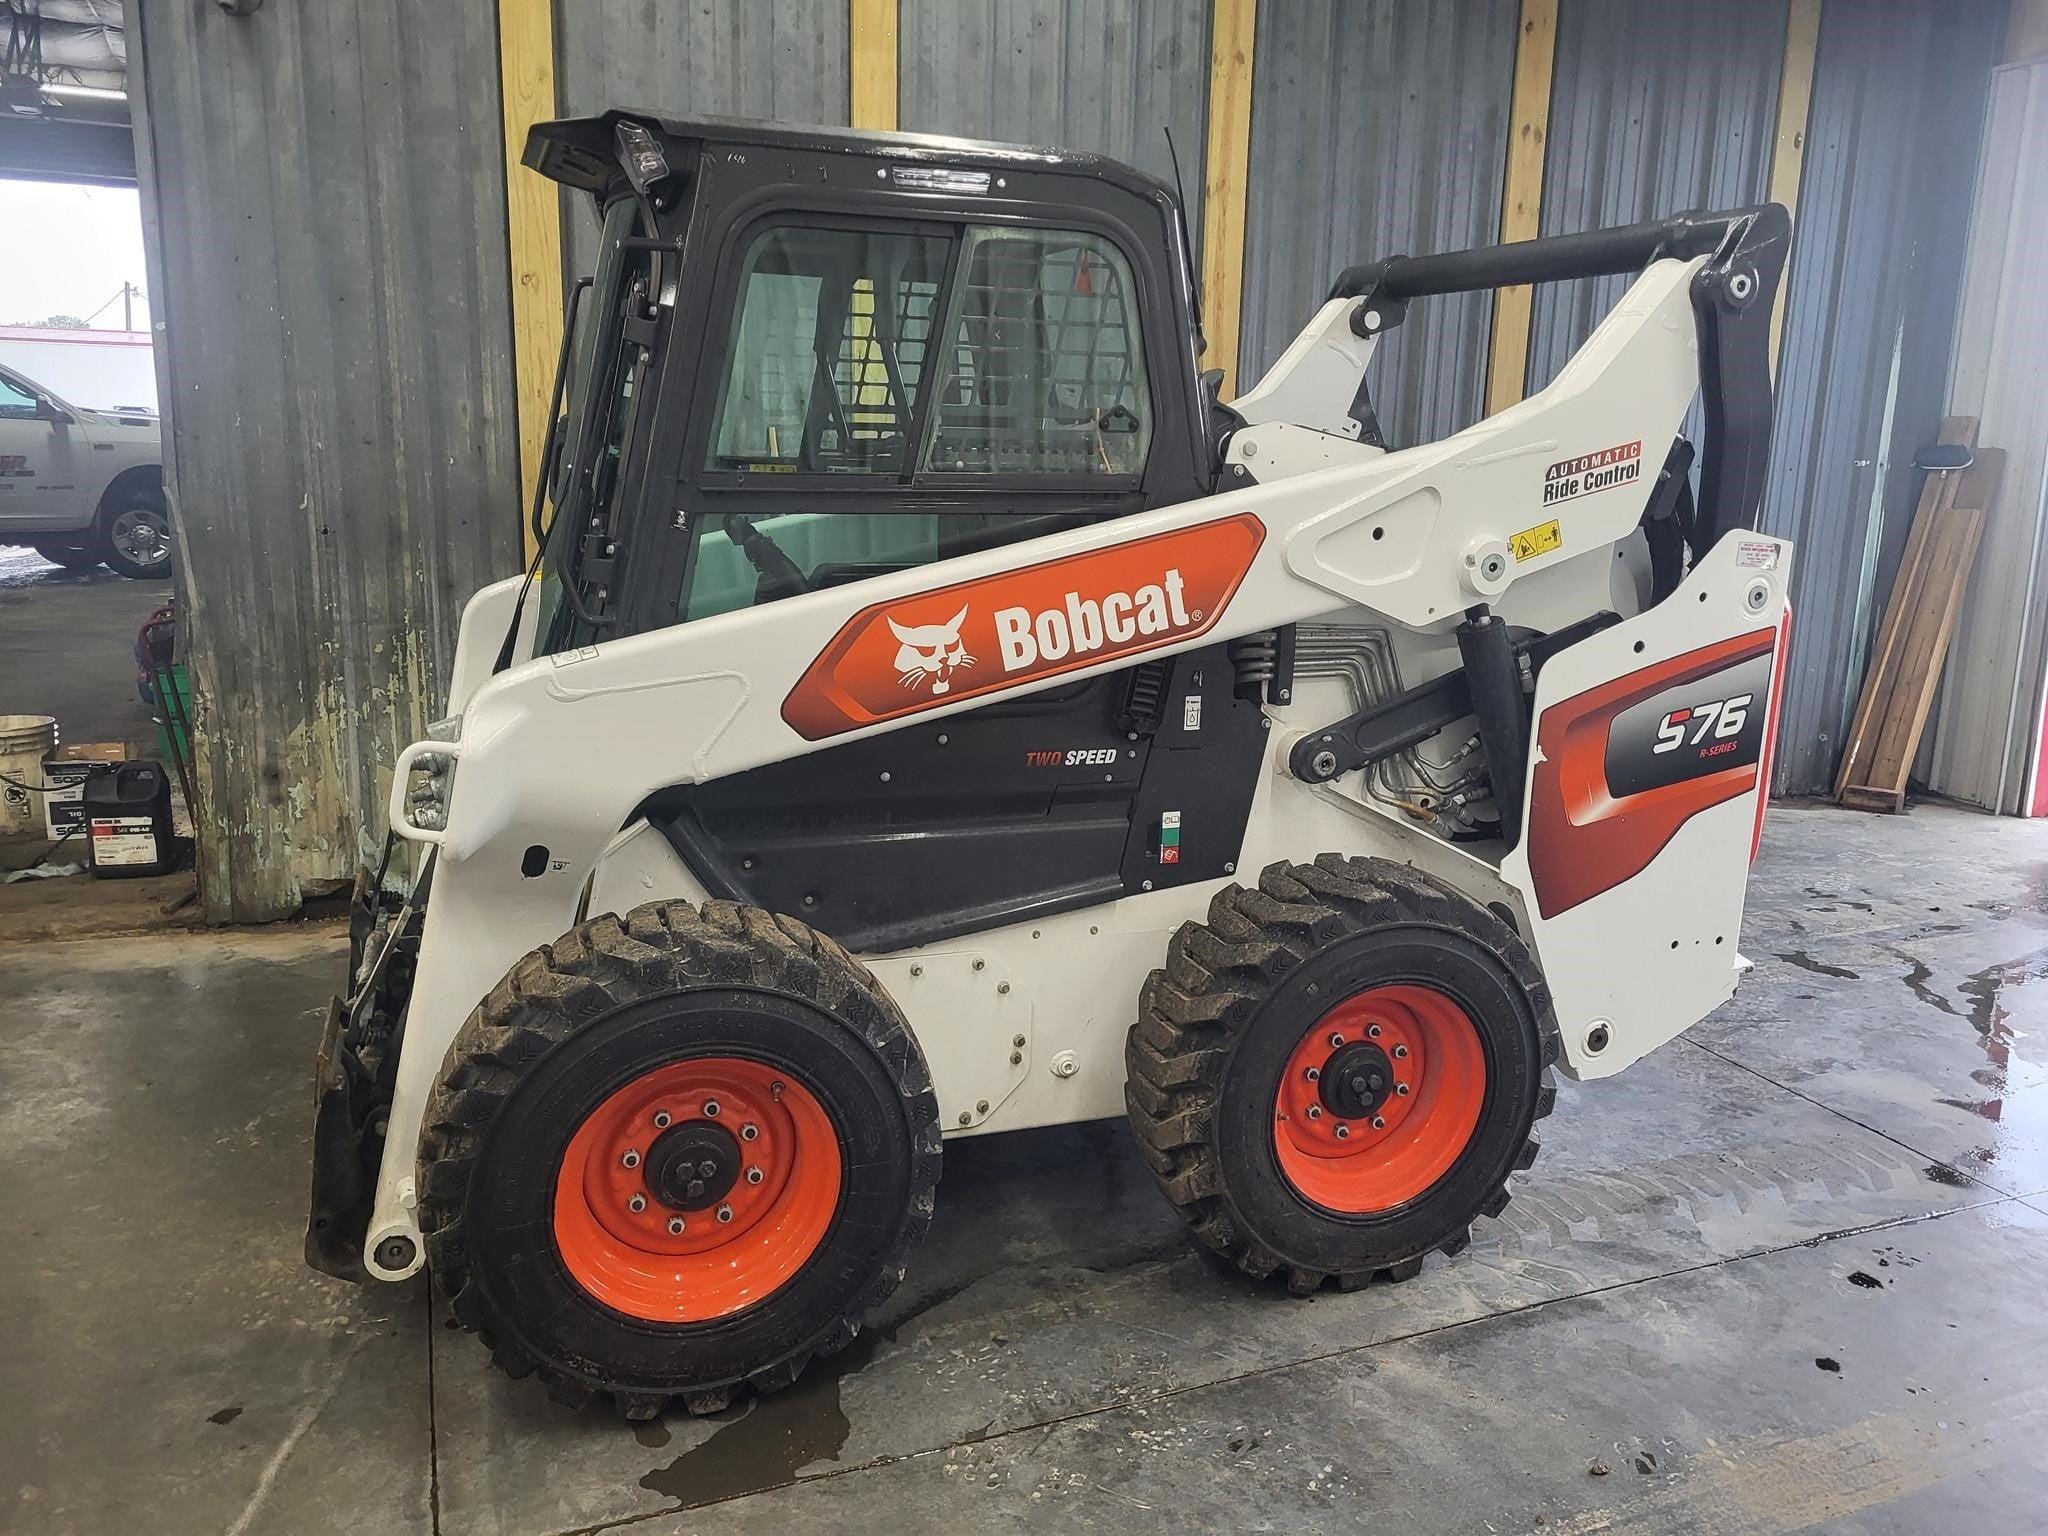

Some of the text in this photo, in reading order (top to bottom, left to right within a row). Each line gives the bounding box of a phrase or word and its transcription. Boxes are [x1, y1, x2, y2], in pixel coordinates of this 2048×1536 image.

[1543, 459, 1640, 503] Ride Control
[1549, 444, 1638, 480] AUTOMATIC
[994, 568, 1190, 672] Bobcat
[1653, 693, 1753, 754] S76
[1026, 748, 1117, 768] TWO SPEED
[1699, 741, 1738, 758] R-SERIES
